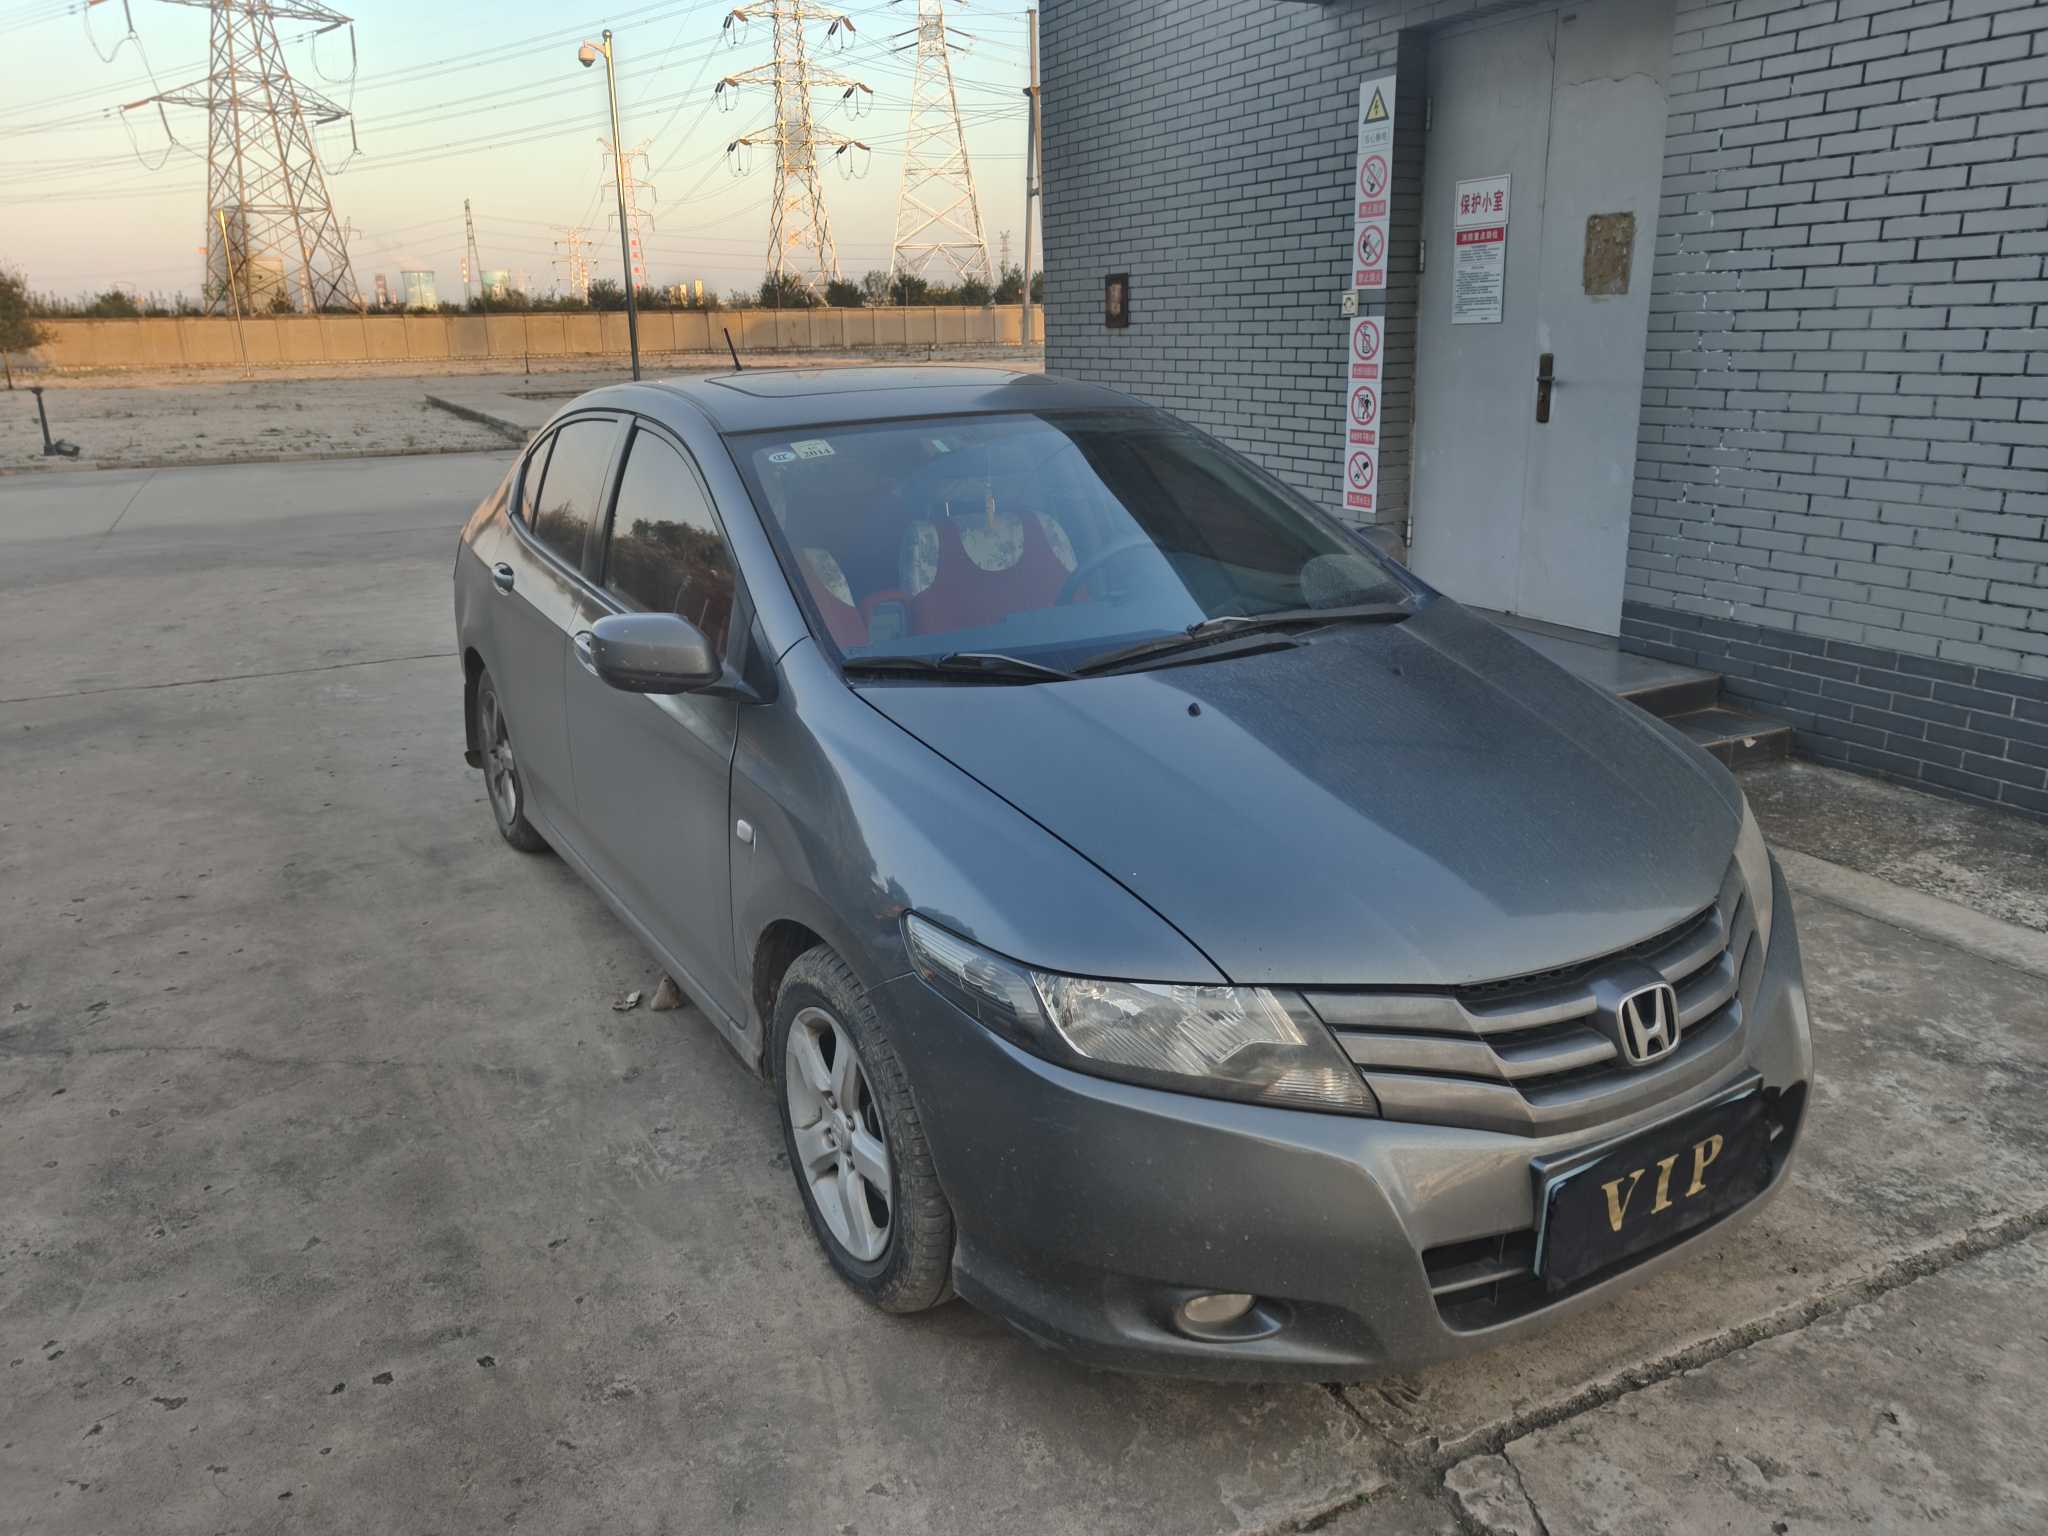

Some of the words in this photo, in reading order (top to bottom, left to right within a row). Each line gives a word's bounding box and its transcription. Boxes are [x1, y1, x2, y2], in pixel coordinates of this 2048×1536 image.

[1461, 190, 1504, 214] 保护小室
[1601, 1134, 1723, 1232] VIP
